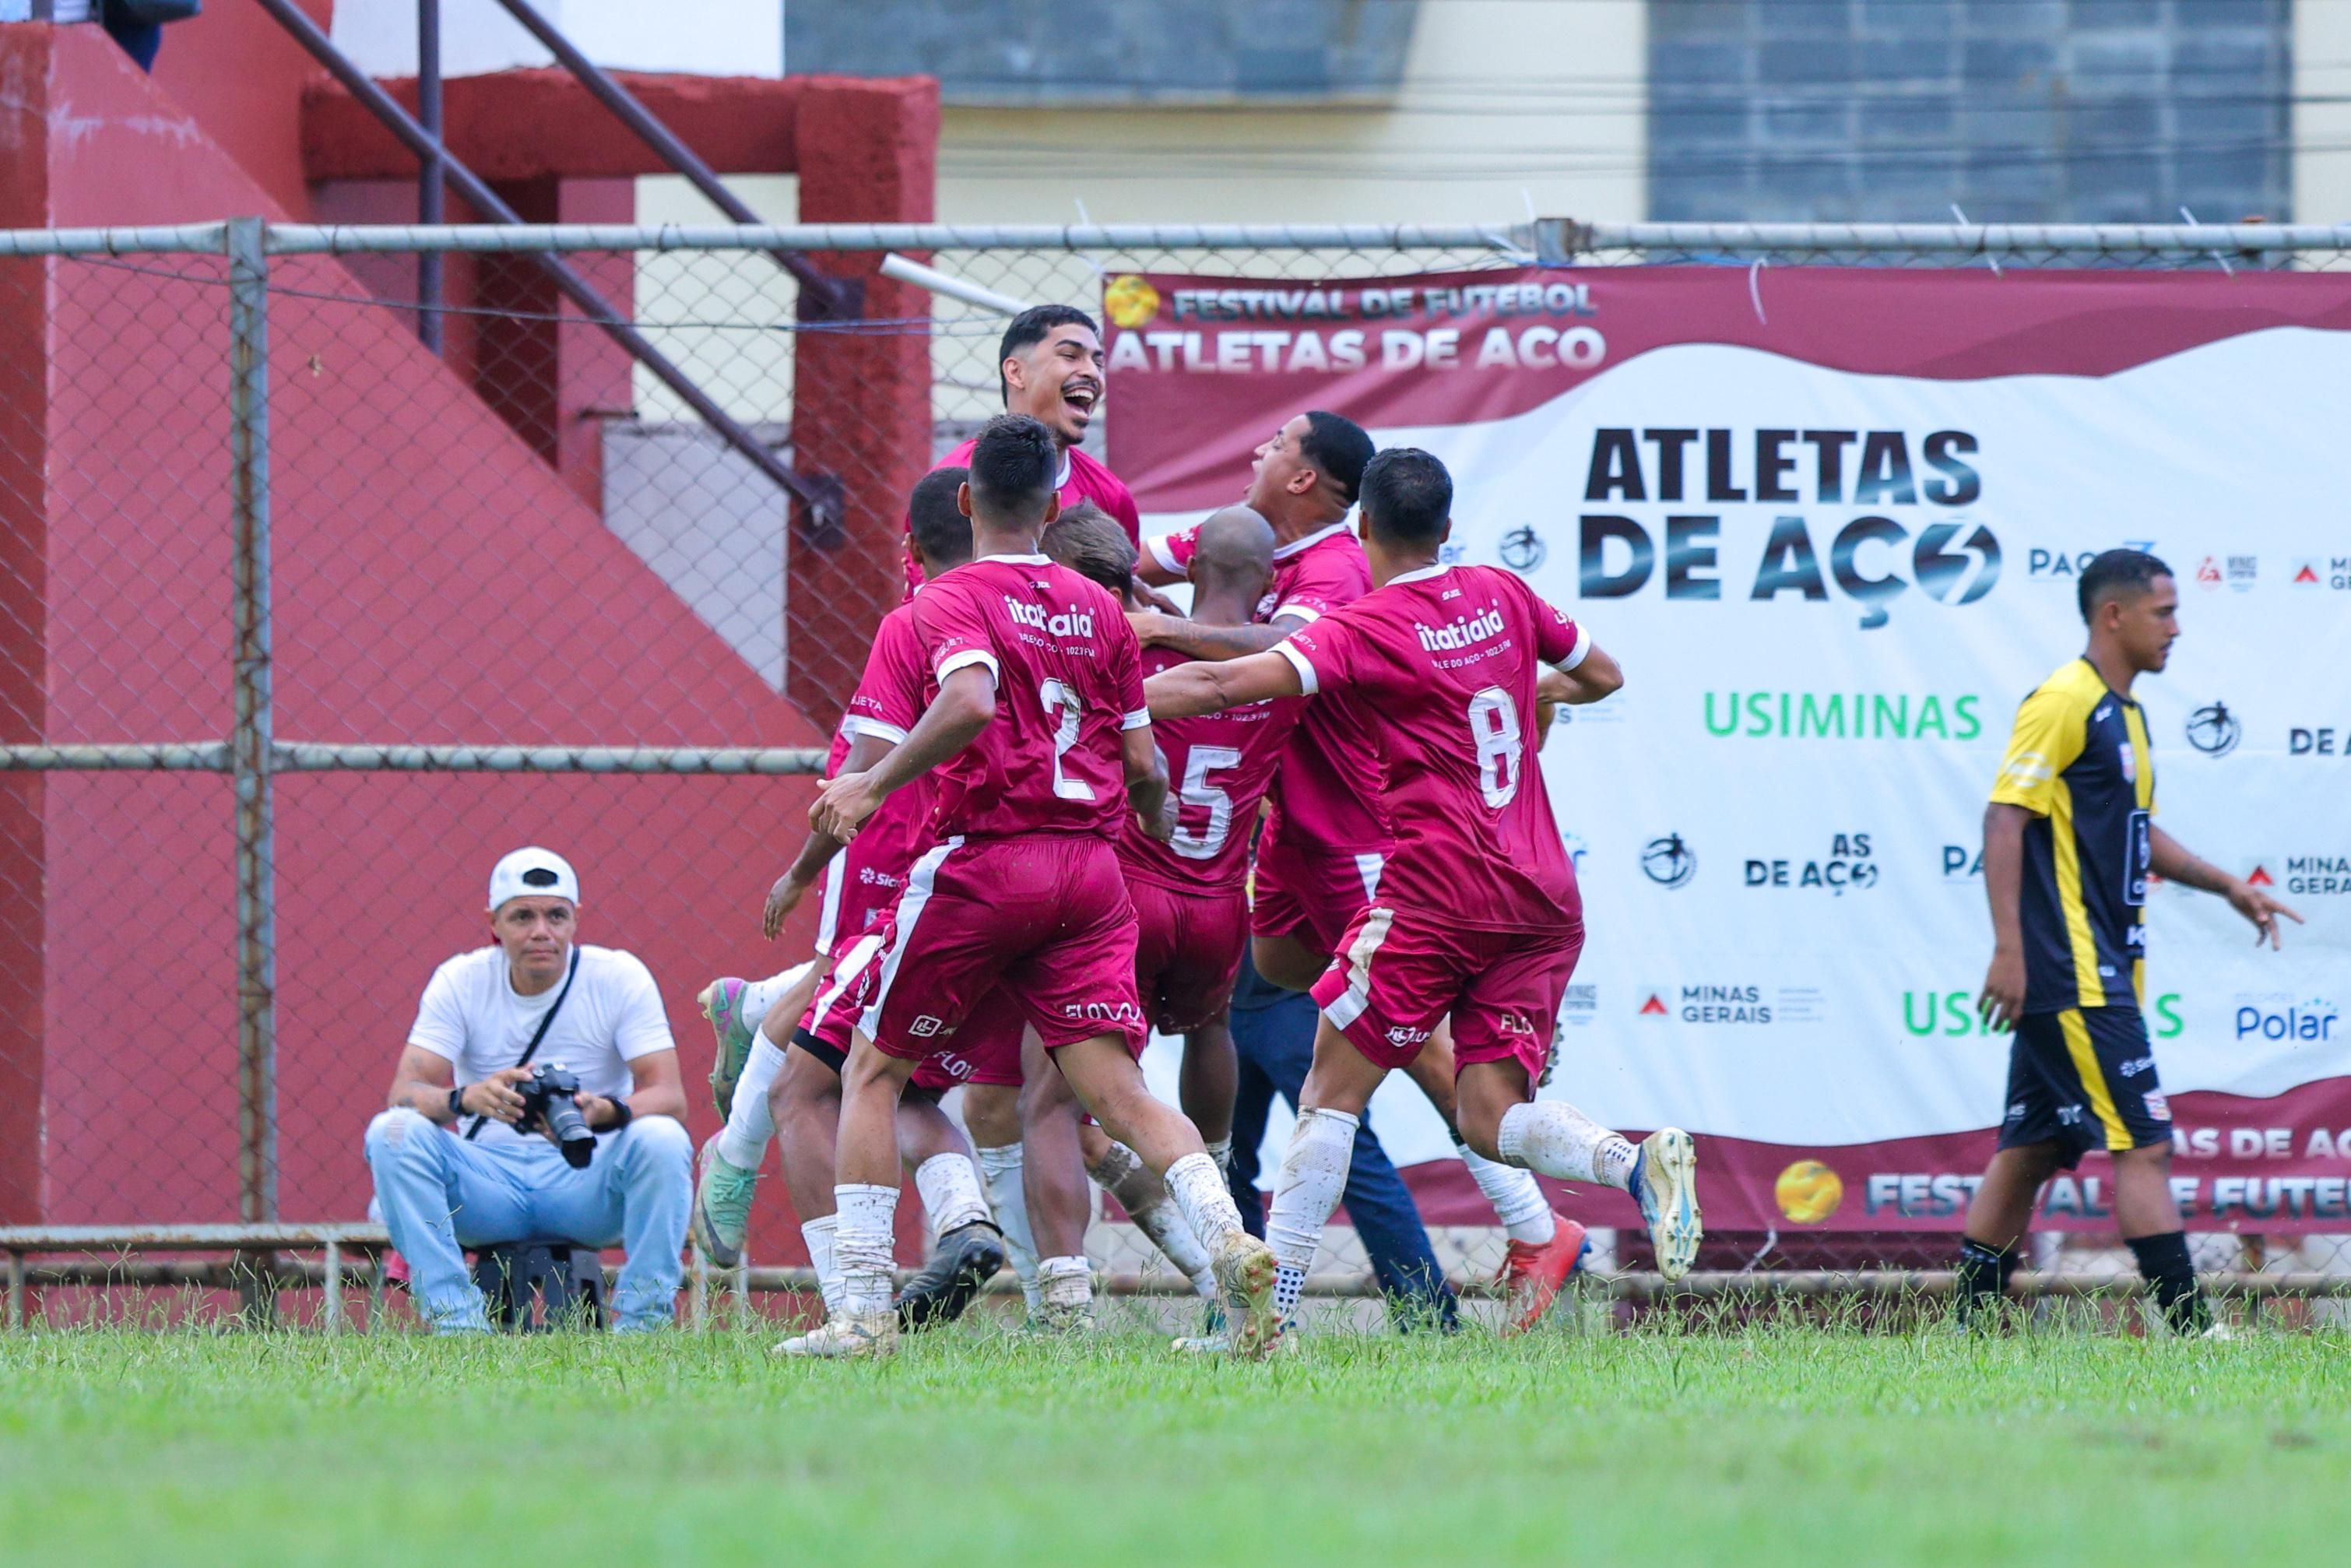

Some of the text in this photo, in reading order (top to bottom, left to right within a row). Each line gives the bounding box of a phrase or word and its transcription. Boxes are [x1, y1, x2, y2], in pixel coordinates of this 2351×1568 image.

[1174, 283, 1597, 321] FESTIVAL DE FUTEBOL
[1109, 329, 1365, 372] ATLETAS
[1380, 329, 1460, 369] DE
[1583, 428, 1980, 506] ATLETAS
[1579, 515, 1720, 599] DE
[1414, 598, 1505, 652] itatiaia
[1705, 692, 1980, 740] USIMINAS
[1039, 677, 1096, 801] 2
[1467, 685, 1523, 810] 8
[2290, 728, 2334, 756] DE
[1168, 744, 1242, 860] 5
[1832, 833, 1871, 858] AS
[1745, 860, 1790, 887] DE
[1682, 986, 1759, 1003] MINAS
[1682, 1007, 1772, 1023] GERAIS
[2236, 1007, 2339, 1041] Polar
[2230, 1127, 2292, 1159] DE
[1866, 1174, 2109, 1218] FESTAL
[2212, 1176, 2351, 1219] FUTE
